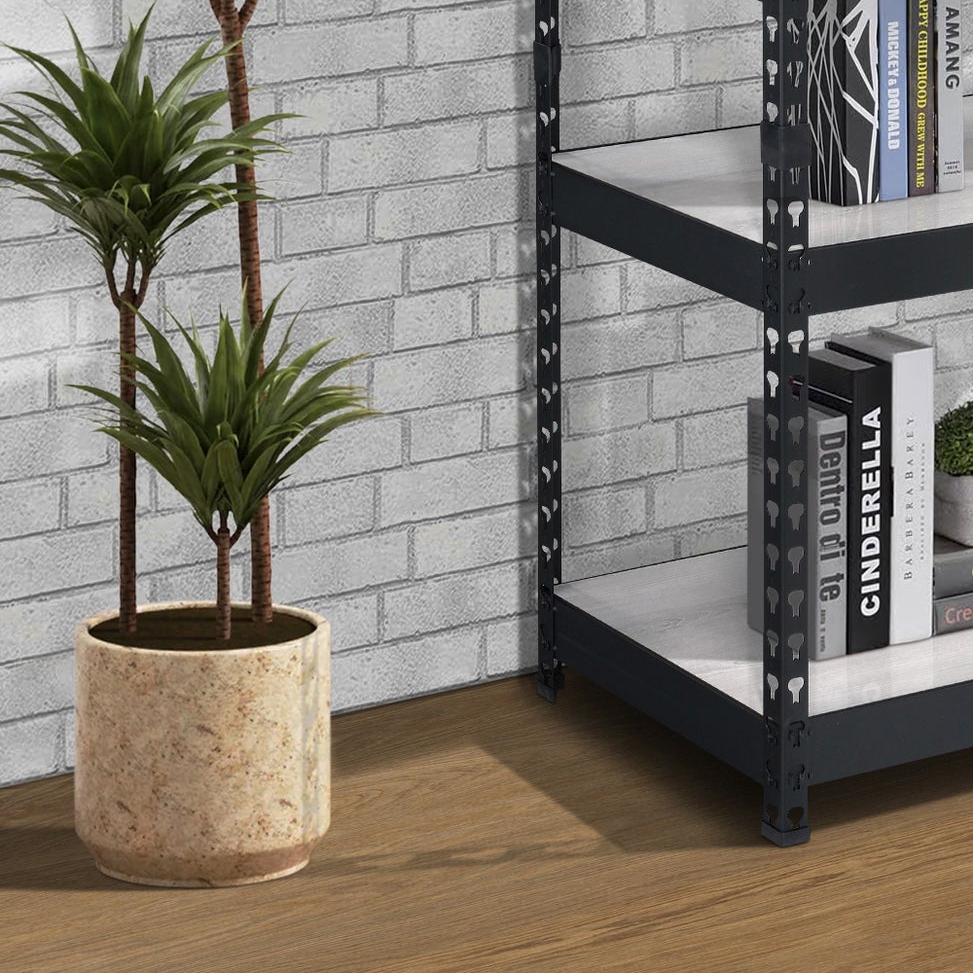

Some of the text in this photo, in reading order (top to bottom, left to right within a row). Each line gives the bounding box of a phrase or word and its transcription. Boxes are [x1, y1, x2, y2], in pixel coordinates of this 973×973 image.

[887, 21, 899, 77] MICKEY
[916, 30, 929, 108] CHILDHOOD
[945, 6, 960, 90] AMANG
[887, 88, 900, 150] DONALD
[917, 112, 926, 142] GREW
[915, 172, 925, 188] ME
[916, 143, 925, 170] WITH
[819, 430, 846, 602] Dentro di te
[860, 406, 882, 617] CINDERELLA
[904, 417, 915, 580] BARBERA BAREY
